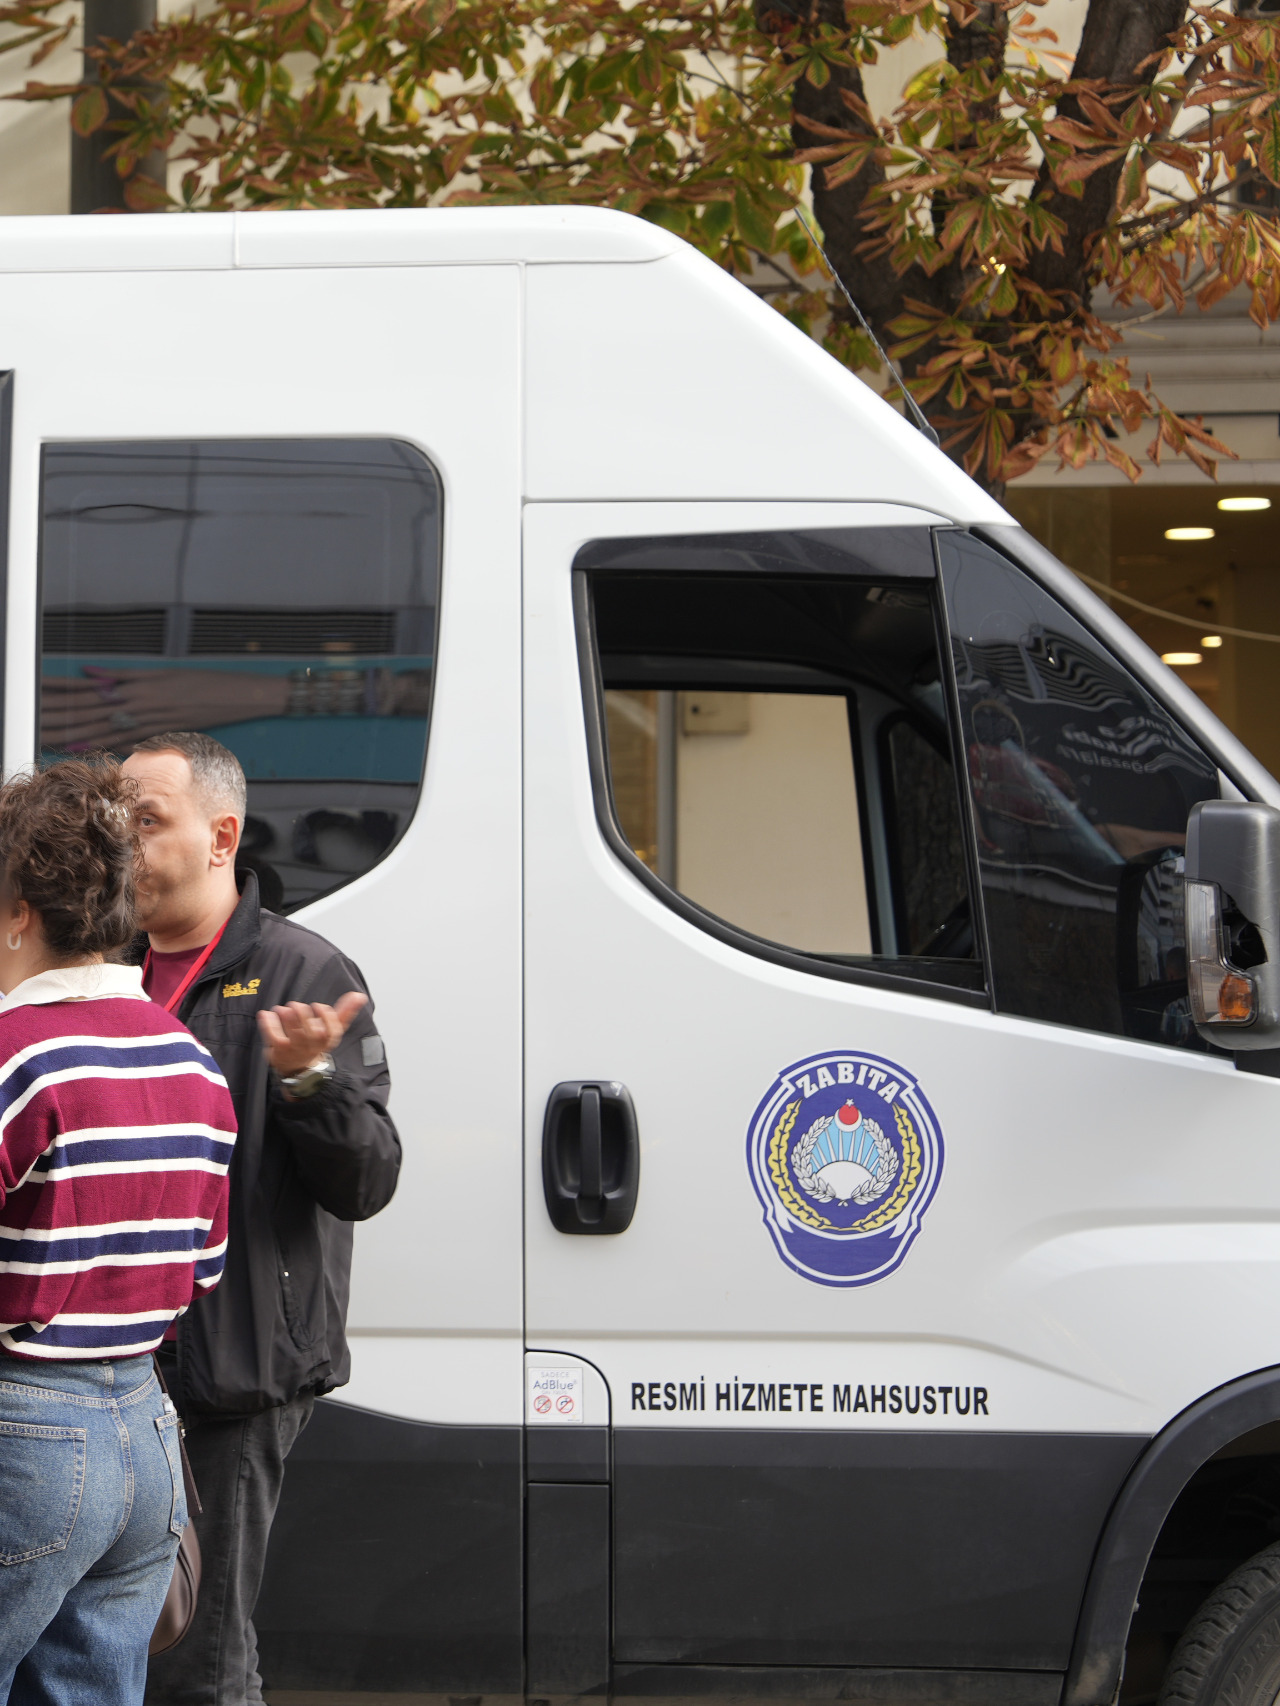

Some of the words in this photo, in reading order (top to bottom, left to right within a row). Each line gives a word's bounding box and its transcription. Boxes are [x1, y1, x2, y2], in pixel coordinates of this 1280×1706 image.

[795, 1062, 901, 1104] ZABITA
[631, 1375, 706, 1411] RESMİ
[715, 1375, 824, 1412] HİZMETE
[833, 1383, 990, 1416] MAHSUSTUR
